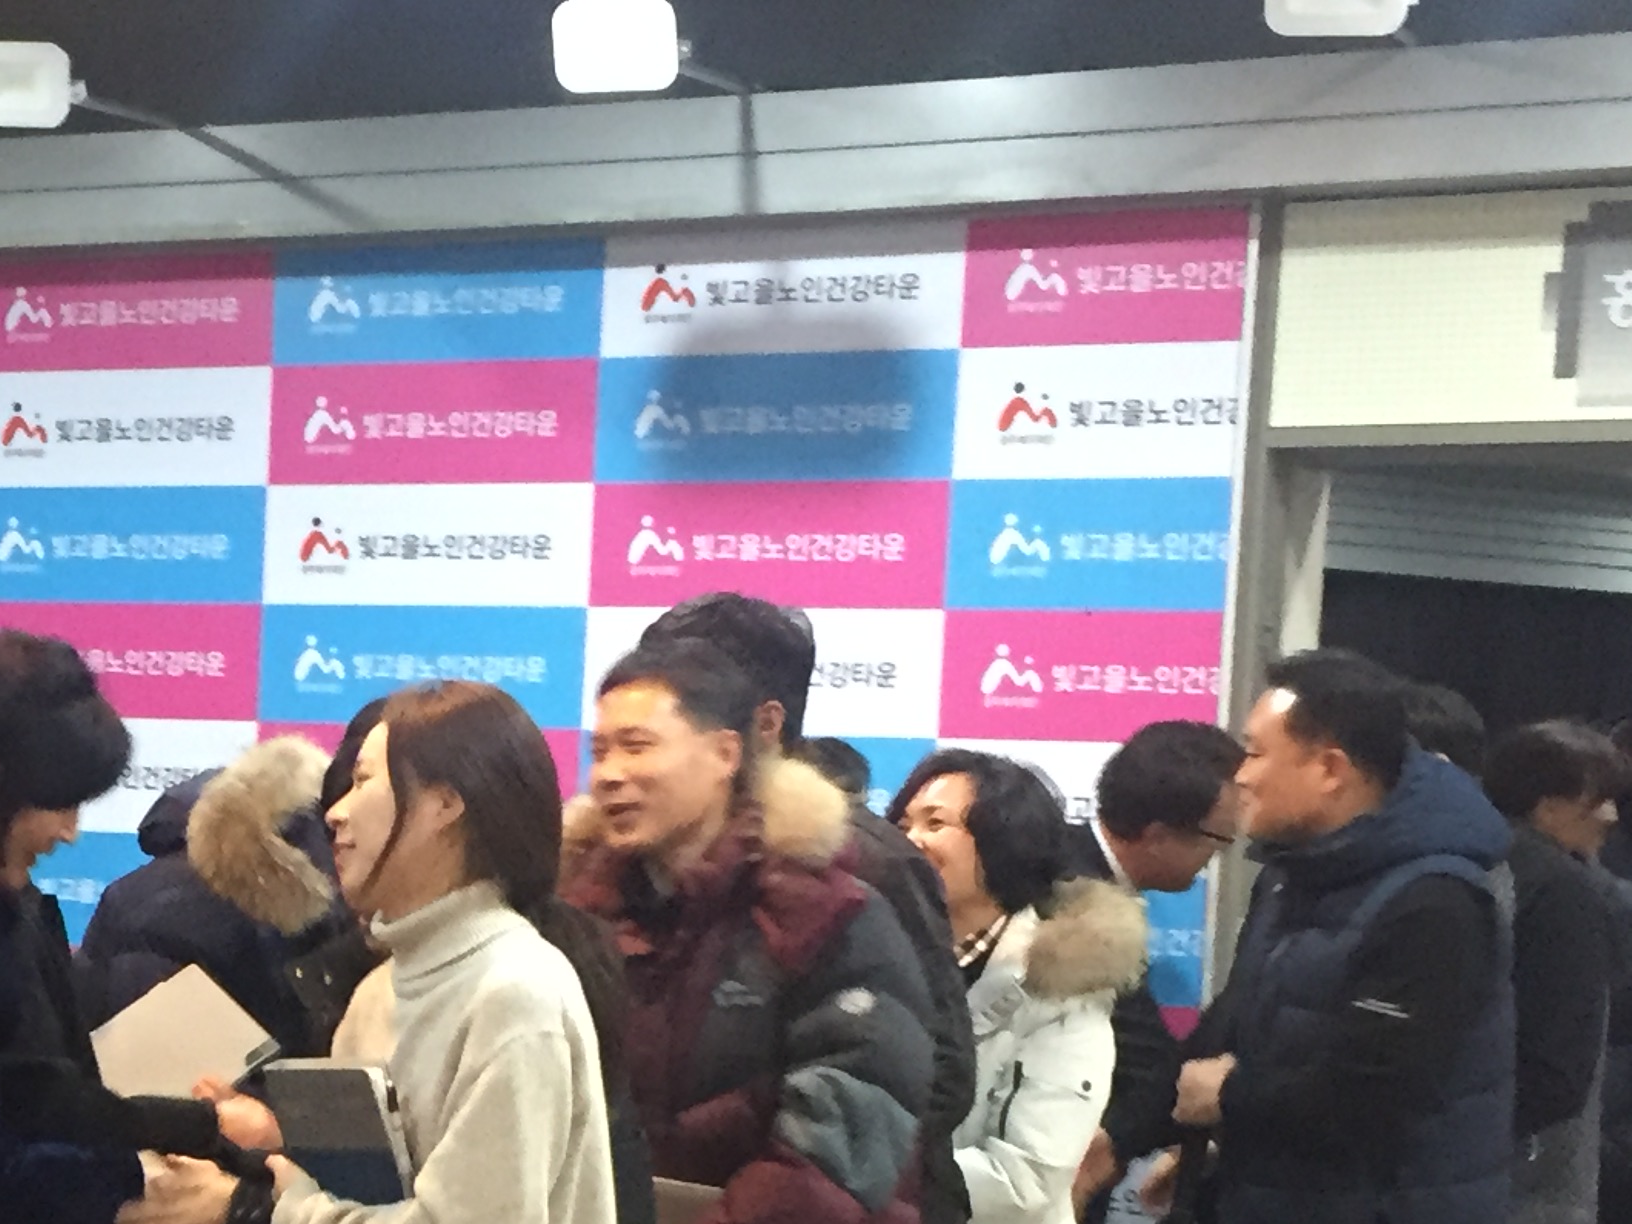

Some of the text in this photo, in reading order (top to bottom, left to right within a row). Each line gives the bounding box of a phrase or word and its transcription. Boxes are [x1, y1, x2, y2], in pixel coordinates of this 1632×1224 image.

[706, 272, 919, 306] 빛고을노인건강타운
[55, 415, 235, 443] 빛고을노인건강타운
[357, 534, 553, 560] 빛고을노인건강타운
[692, 533, 905, 561] 빛고을노인건강타운
[79, 649, 226, 677] 을노인건강타운
